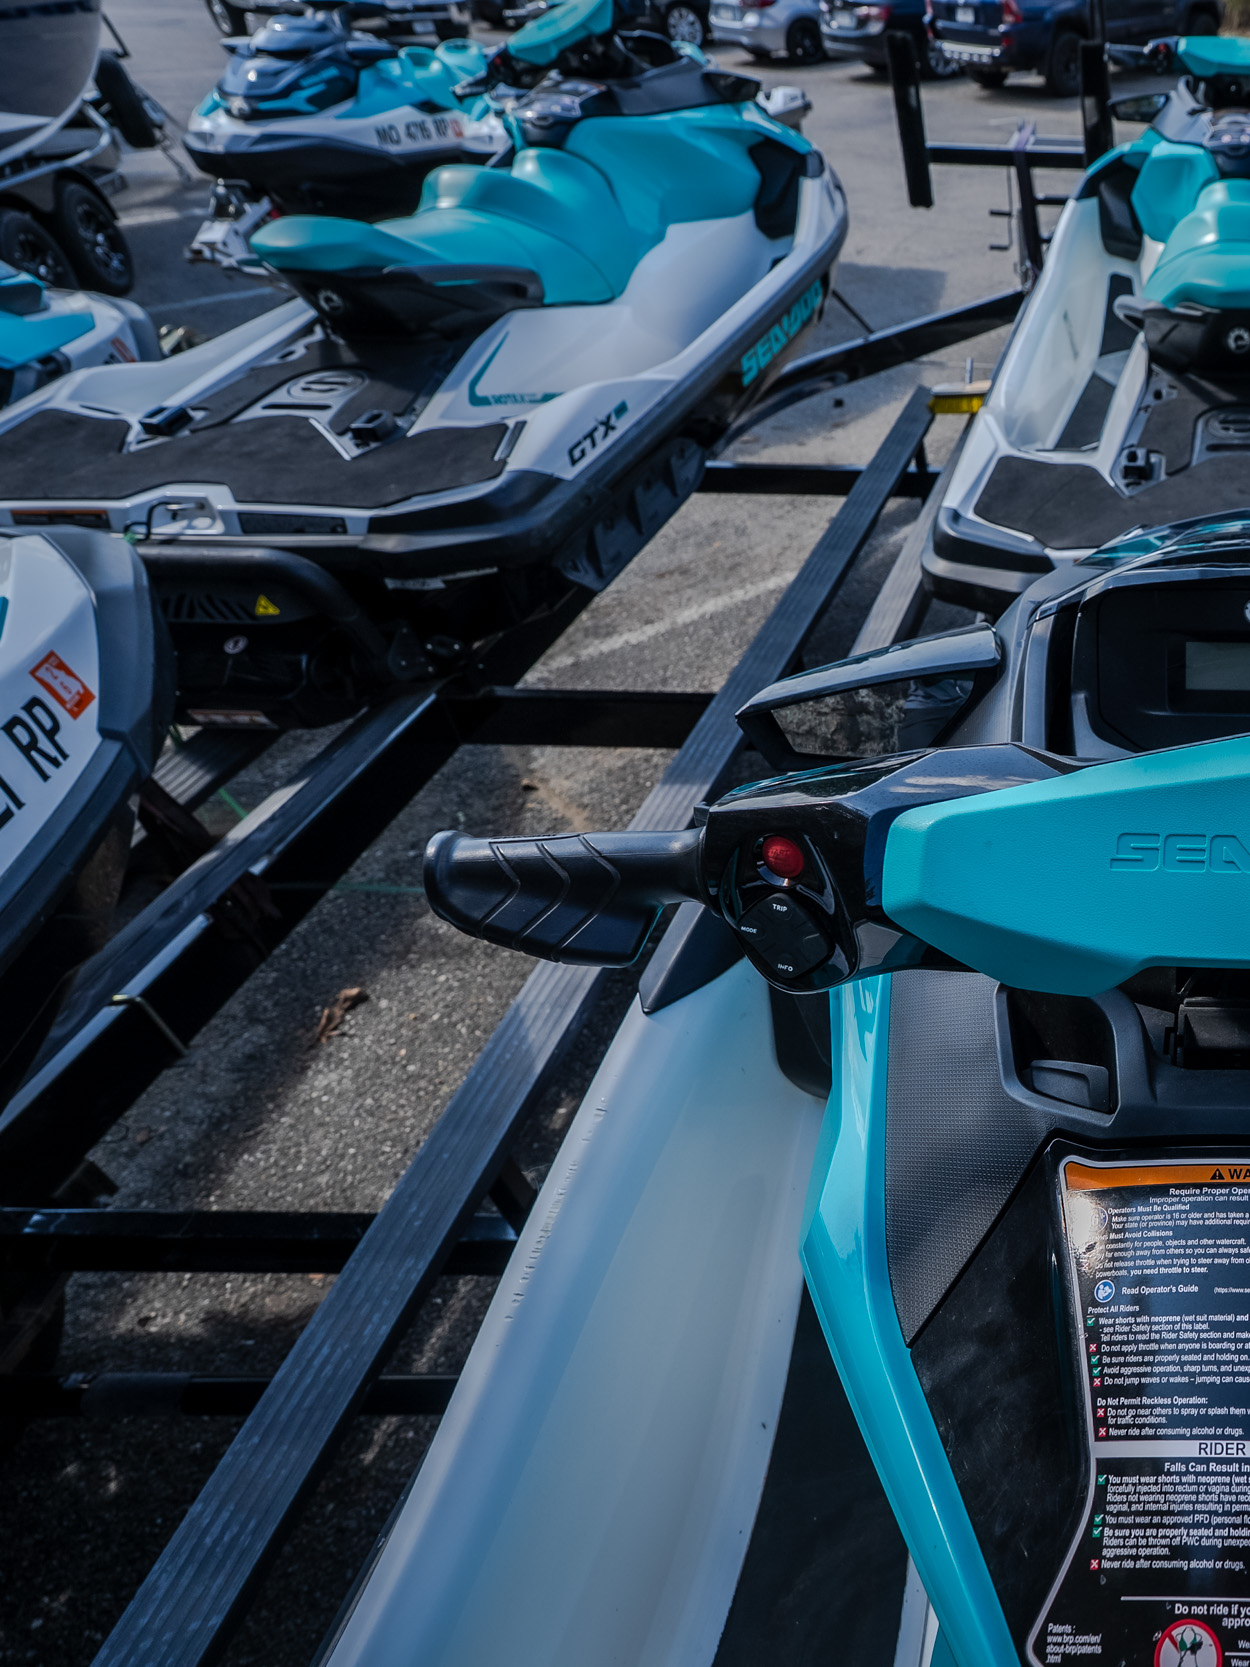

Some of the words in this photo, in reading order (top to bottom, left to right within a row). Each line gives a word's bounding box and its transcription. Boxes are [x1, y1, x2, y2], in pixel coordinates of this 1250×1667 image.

[567, 414, 618, 467] GTX
[1, 695, 69, 783] RP
[772, 903, 788, 912] TRIP
[740, 925, 757, 934] MODE
[777, 963, 793, 972] INFO
[1170, 1186, 1200, 1197] Require
[1202, 1186, 1228, 1196] Proper
[1122, 1285, 1139, 1294] Read
[1141, 1284, 1176, 1296] Operator's
[1178, 1283, 1198, 1293] Guide
[1088, 1304, 1109, 1314] Protect
[1110, 1304, 1118, 1313] All
[1120, 1303, 1140, 1312] Riders
[1099, 1315, 1114, 1324] Wear
[1116, 1314, 1134, 1323] shorts
[1136, 1314, 1149, 1323] with
[1151, 1315, 1180, 1324] neoprene
[1196, 1313, 1207, 1321] suit
[1236, 1313, 1248, 1321] and
[1104, 1365, 1119, 1374] Avoid
[1120, 1364, 1151, 1376] aggressive
[1184, 1363, 1200, 1374] sharp
[1220, 1363, 1232, 1372] and
[1097, 1397, 1106, 1406] Do
[1107, 1396, 1118, 1406] Not
[1120, 1396, 1140, 1405] Permit
[1142, 1395, 1171, 1405] Reckless
[1173, 1394, 1208, 1406] Operation:
[1109, 1427, 1127, 1436] Never
[1128, 1427, 1140, 1435] ride
[1141, 1427, 1155, 1435] after
[1156, 1426, 1190, 1437] consuming
[1192, 1426, 1214, 1435] alcohol
[1224, 1426, 1244, 1436] drugs.
[1198, 1442, 1246, 1456] RIDER
[1165, 1462, 1186, 1472] Falls
[1189, 1462, 1206, 1472] Can
[1210, 1462, 1239, 1472] Result
[1242, 1463, 1250, 1472] in
[1109, 1474, 1121, 1484] You
[1122, 1474, 1139, 1484] must
[1158, 1474, 1179, 1483] shorts
[1182, 1474, 1196, 1483] with
[1198, 1476, 1230, 1485] neoprene
[1105, 1514, 1117, 1523] You
[1118, 1514, 1134, 1523] must
[1162, 1514, 1193, 1526] approved
[1194, 1515, 1209, 1524] PFD
[1104, 1527, 1113, 1536] Be
[1131, 1529, 1144, 1538] you
[1158, 1527, 1187, 1538] properly
[1189, 1527, 1213, 1536] seated
[1214, 1527, 1228, 1536] and
[1101, 1559, 1120, 1568] Never
[1122, 1559, 1134, 1568] ride
[1136, 1559, 1150, 1568] after
[1152, 1559, 1188, 1570] consuming
[1190, 1559, 1214, 1568] alcohol
[1224, 1560, 1245, 1571] drugs.
[1175, 1604, 1188, 1614] Do
[1191, 1604, 1207, 1615] not
[1210, 1604, 1228, 1615] ride
[1232, 1604, 1238, 1615] if
[1048, 1623, 1072, 1633] Patents
